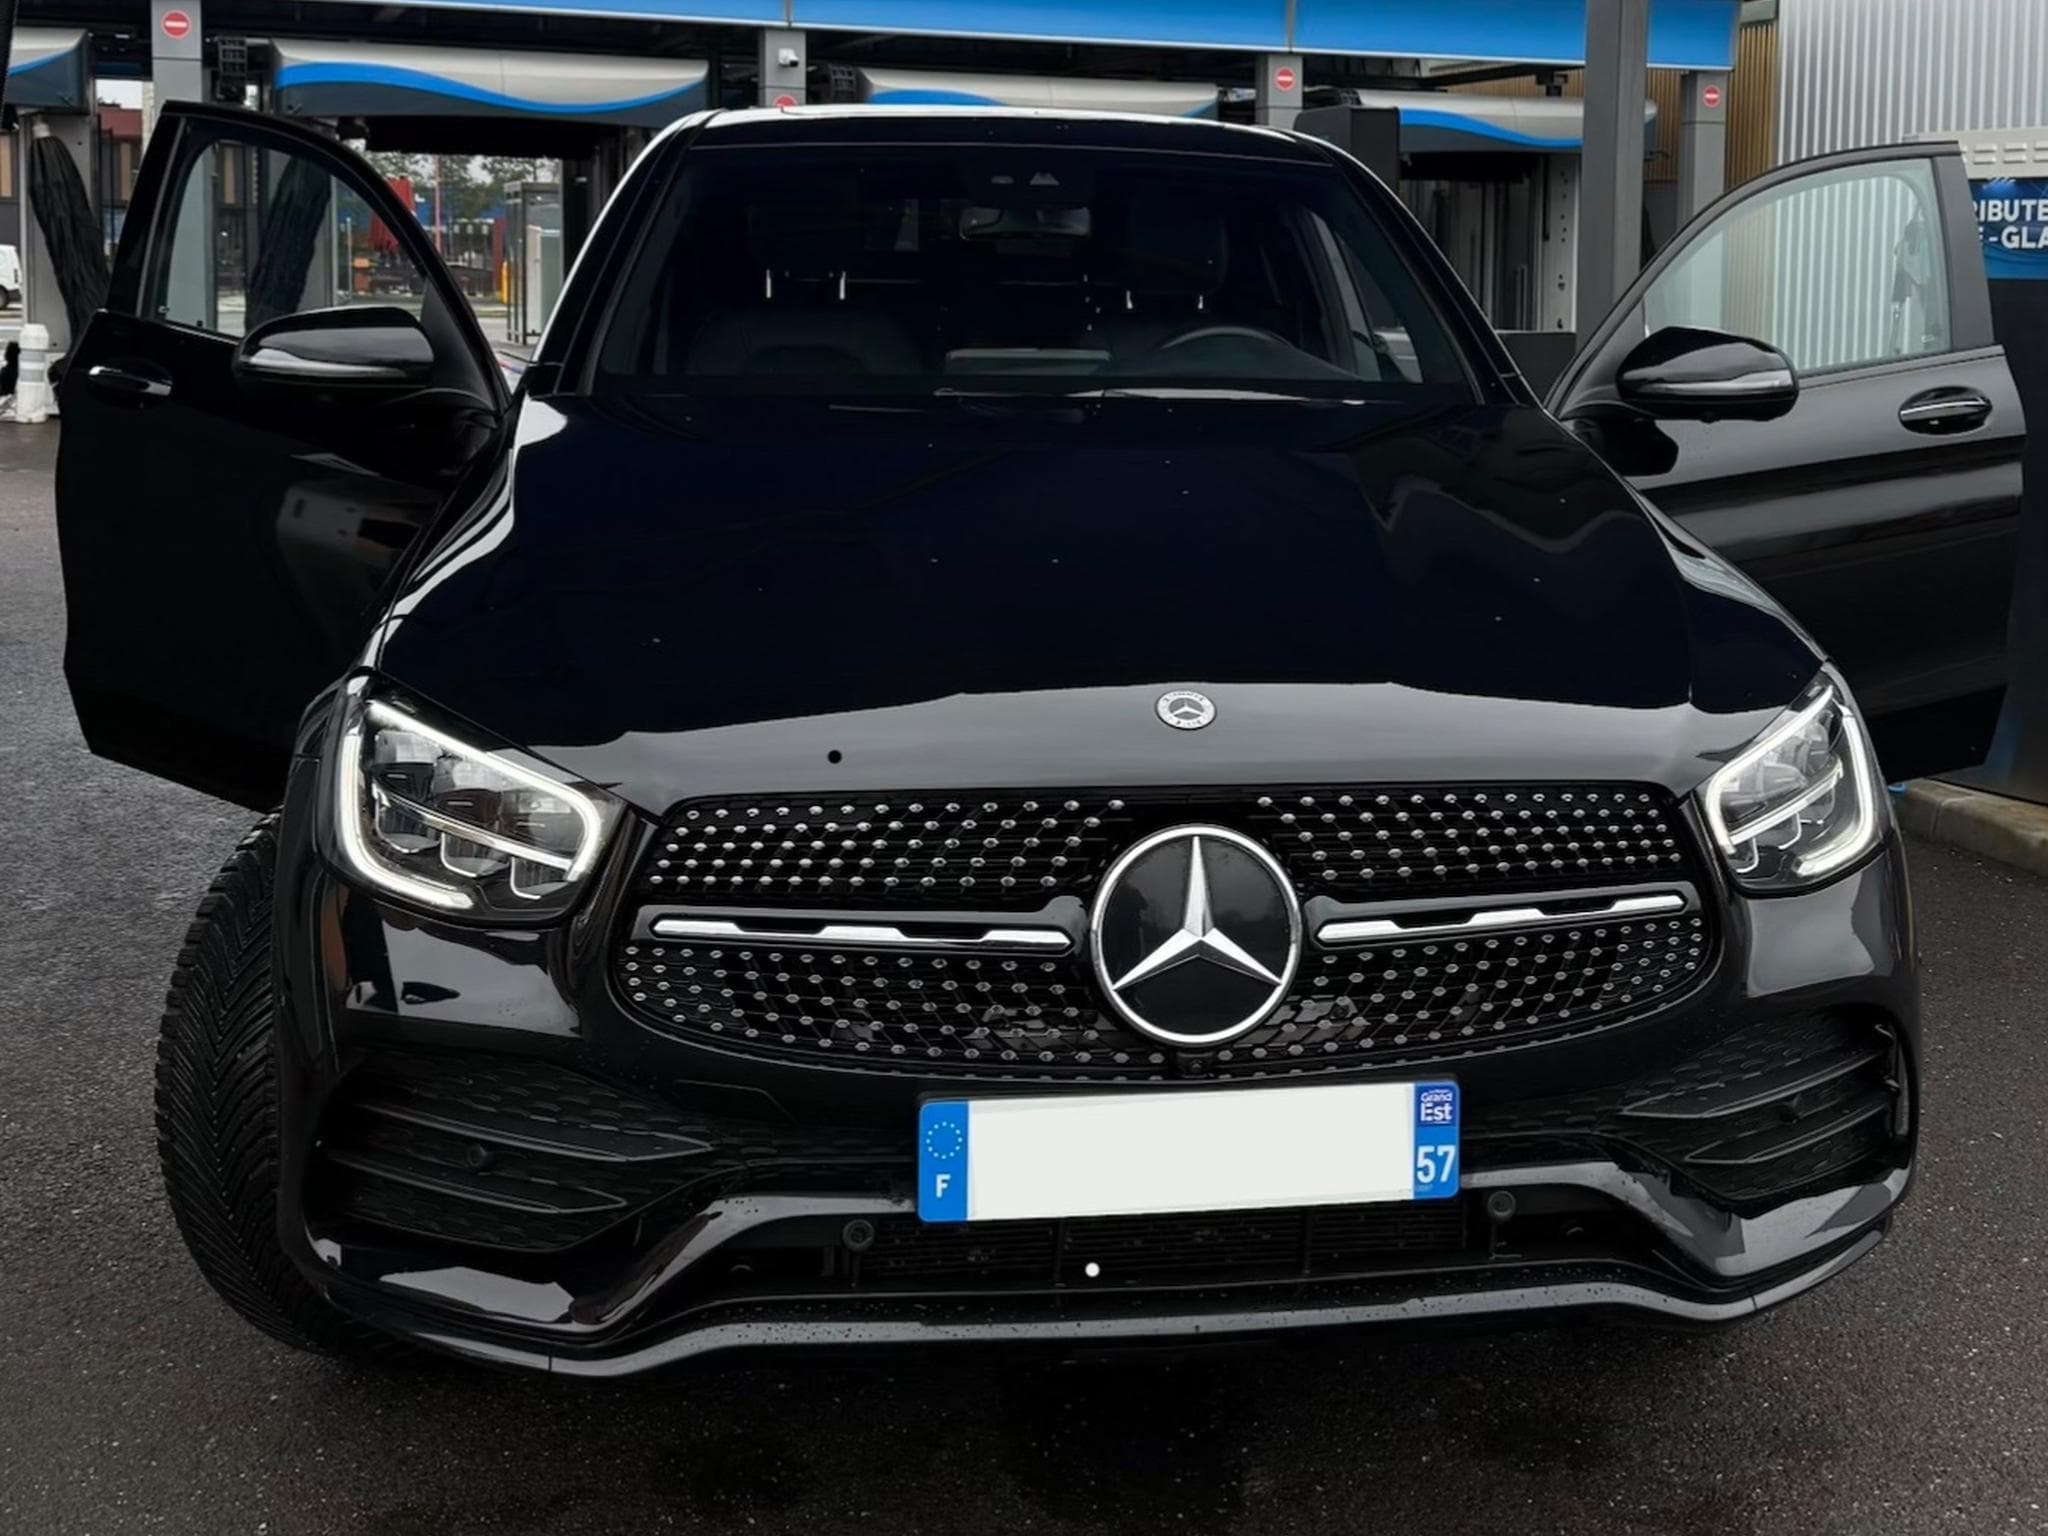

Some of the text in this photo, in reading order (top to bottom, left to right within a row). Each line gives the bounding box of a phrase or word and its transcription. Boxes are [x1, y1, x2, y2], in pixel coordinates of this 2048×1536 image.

[1420, 1091, 1453, 1102] Grand
[1420, 1102, 1453, 1121] Est
[1416, 1144, 1456, 1183] 57
[936, 1173, 951, 1198] F
